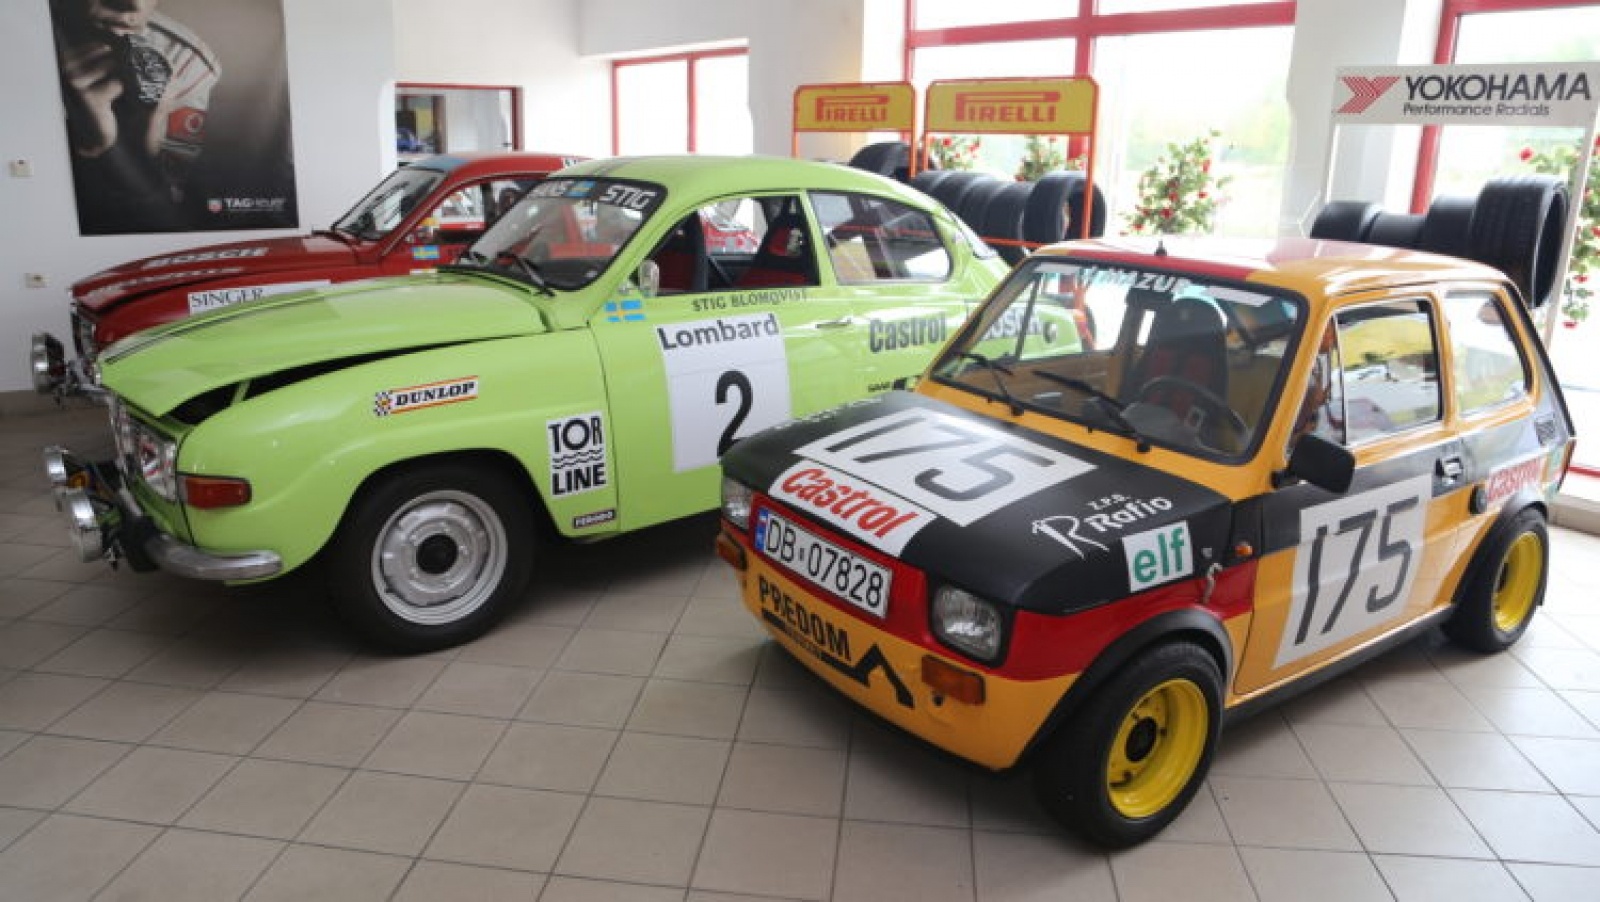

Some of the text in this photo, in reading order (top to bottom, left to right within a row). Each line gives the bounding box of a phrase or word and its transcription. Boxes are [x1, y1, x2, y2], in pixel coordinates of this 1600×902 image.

[1405, 72, 1591, 101] YOKOHAMA
[815, 94, 890, 122] PIRELLI
[955, 91, 1061, 123] PIRELLI
[1403, 102, 1551, 117] Performance Radials
[600, 184, 657, 210] STIG
[190, 287, 264, 309] SINGER
[691, 288, 807, 312] STIG BLOMQVIST
[656, 312, 779, 351] Lombard
[869, 310, 947, 354] Castrol
[396, 381, 475, 406] DUNLOP
[714, 369, 754, 459] 2
[548, 415, 603, 453] TOR
[824, 415, 1057, 502] 175
[551, 462, 607, 496] LINE
[780, 467, 920, 539] Castrol
[766, 518, 884, 609] DB 07828
[1132, 526, 1185, 584] elf
[1294, 495, 1420, 645] 175
[758, 575, 852, 661] PREDOM
